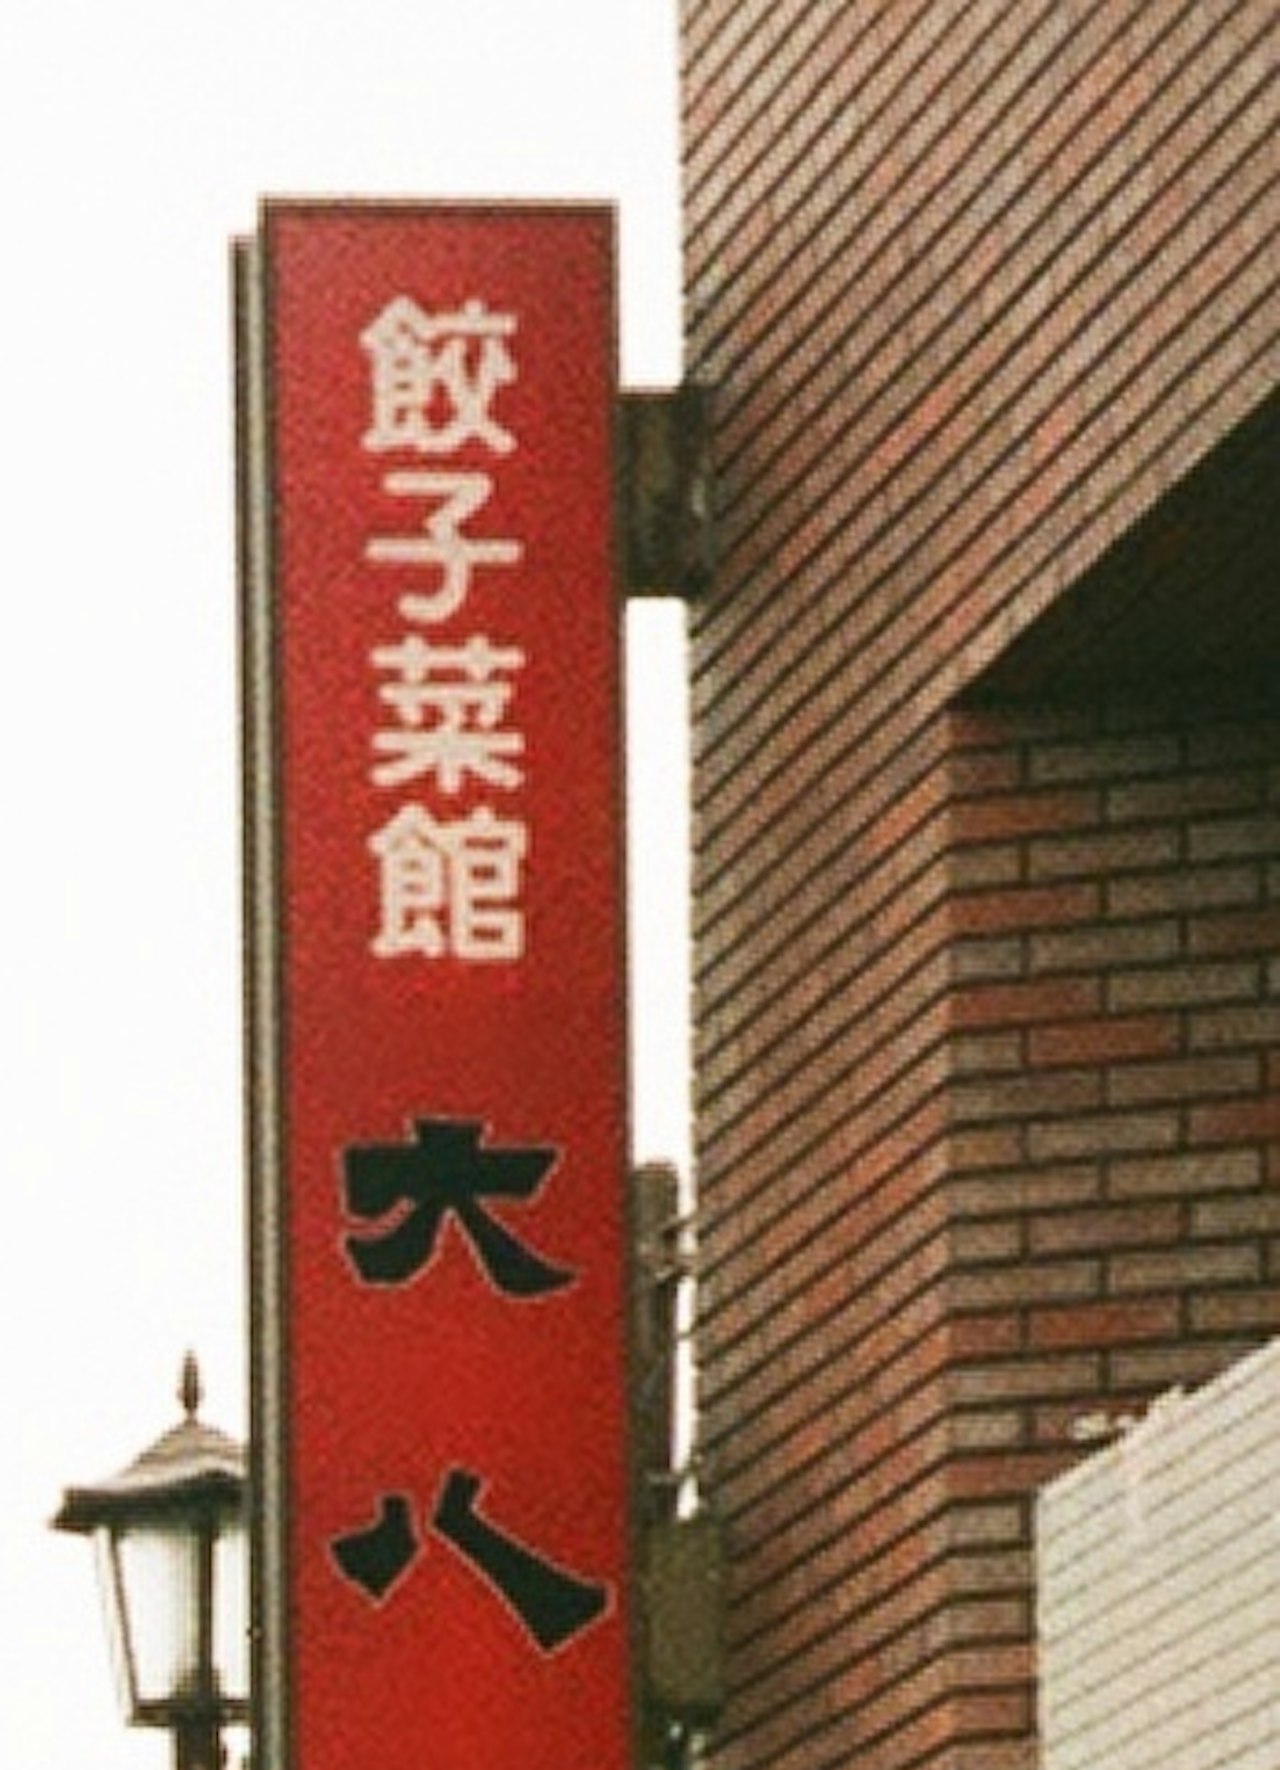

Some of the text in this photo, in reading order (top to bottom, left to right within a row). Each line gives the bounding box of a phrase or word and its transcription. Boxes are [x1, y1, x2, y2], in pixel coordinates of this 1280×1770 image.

[358, 296, 528, 962] 餃子菜館
[328, 1116, 616, 1656] 大八
